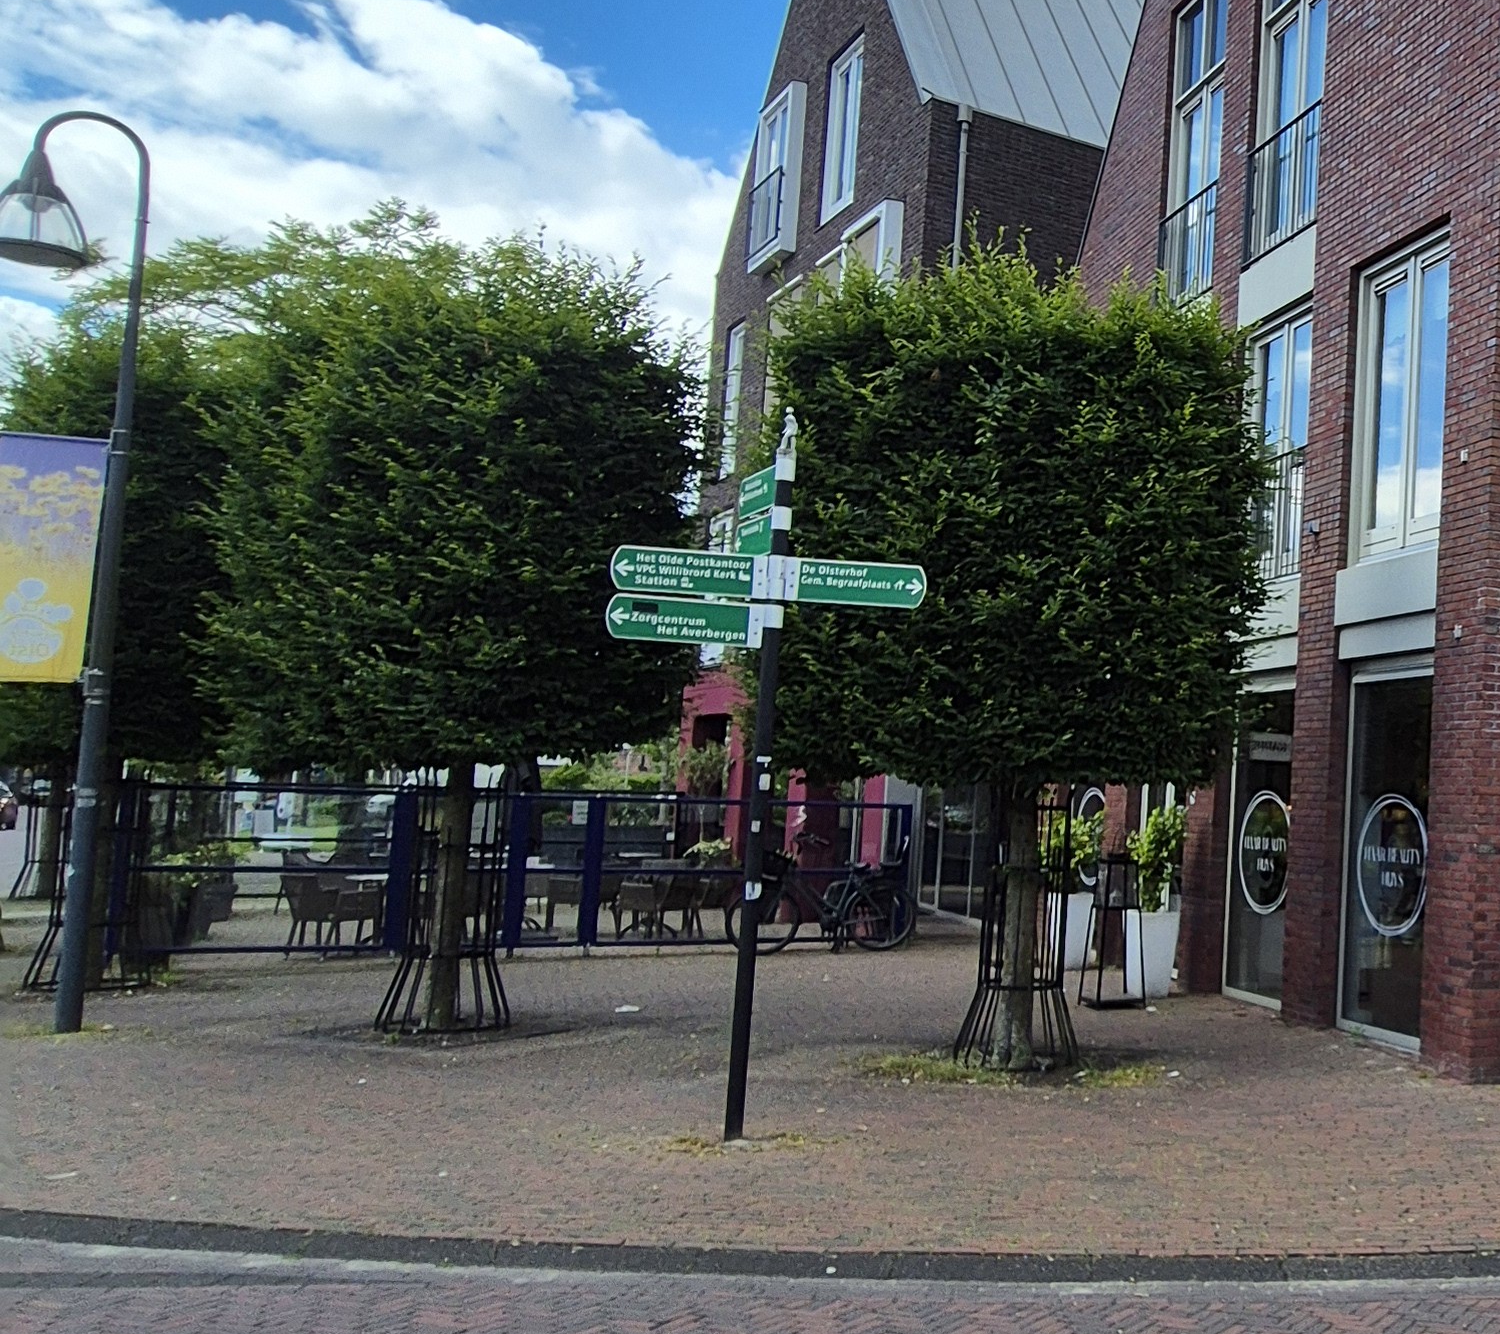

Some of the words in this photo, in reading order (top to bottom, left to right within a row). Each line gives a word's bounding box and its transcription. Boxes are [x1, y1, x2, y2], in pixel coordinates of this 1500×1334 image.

[636, 553, 655, 563] Het
[658, 555, 683, 565] Olde
[686, 556, 752, 569] Postkantoor
[636, 564, 656, 574] VPG
[659, 566, 711, 578] Willibrord
[713, 569, 736, 579] Kerk
[802, 564, 816, 574] De
[818, 566, 868, 577] Olsterhof
[634, 575, 677, 586] Station
[801, 575, 824, 585] Gem.
[826, 576, 891, 590] Begraafplaats
[630, 611, 706, 627] Zorgcentrum
[656, 625, 677, 635] Het
[680, 627, 746, 641] Averbergen
